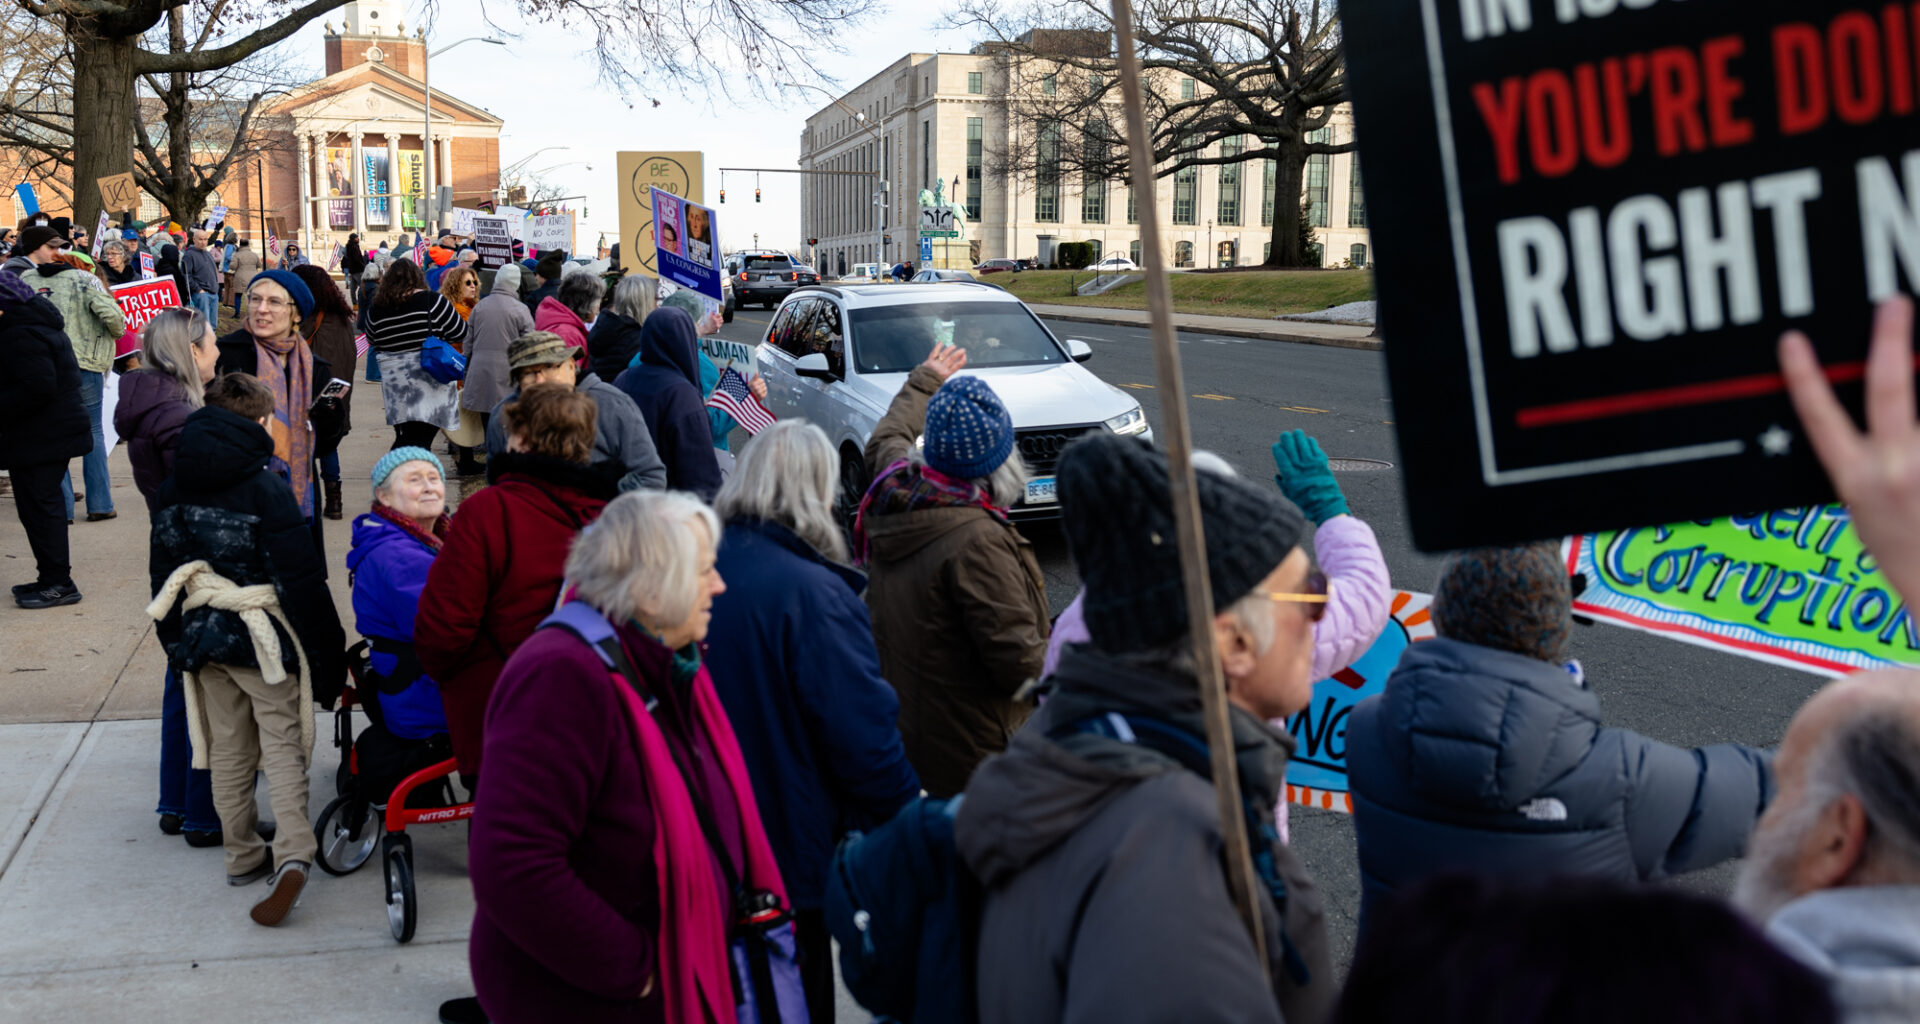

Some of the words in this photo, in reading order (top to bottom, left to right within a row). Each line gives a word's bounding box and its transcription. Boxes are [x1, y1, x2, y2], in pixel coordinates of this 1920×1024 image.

[1471, 35, 1754, 184] YOU'RE
[1771, 2, 1920, 135] DOI
[650, 163, 670, 177] BE
[106, 182, 134, 202] ICE
[411, 153, 422, 214] shuck
[459, 210, 477, 221] NO
[661, 202, 675, 218] NO
[535, 217, 544, 227] NO
[533, 229, 543, 238] NO
[923, 238, 930, 248] H
[675, 258, 711, 279] CONGRESS
[1496, 168, 1823, 359] RIGHT
[118, 288, 172, 312] TRUTH
[123, 308, 164, 330] MATT
[702, 338, 749, 365] HUMAN
[418, 809, 456, 822] NITRO
